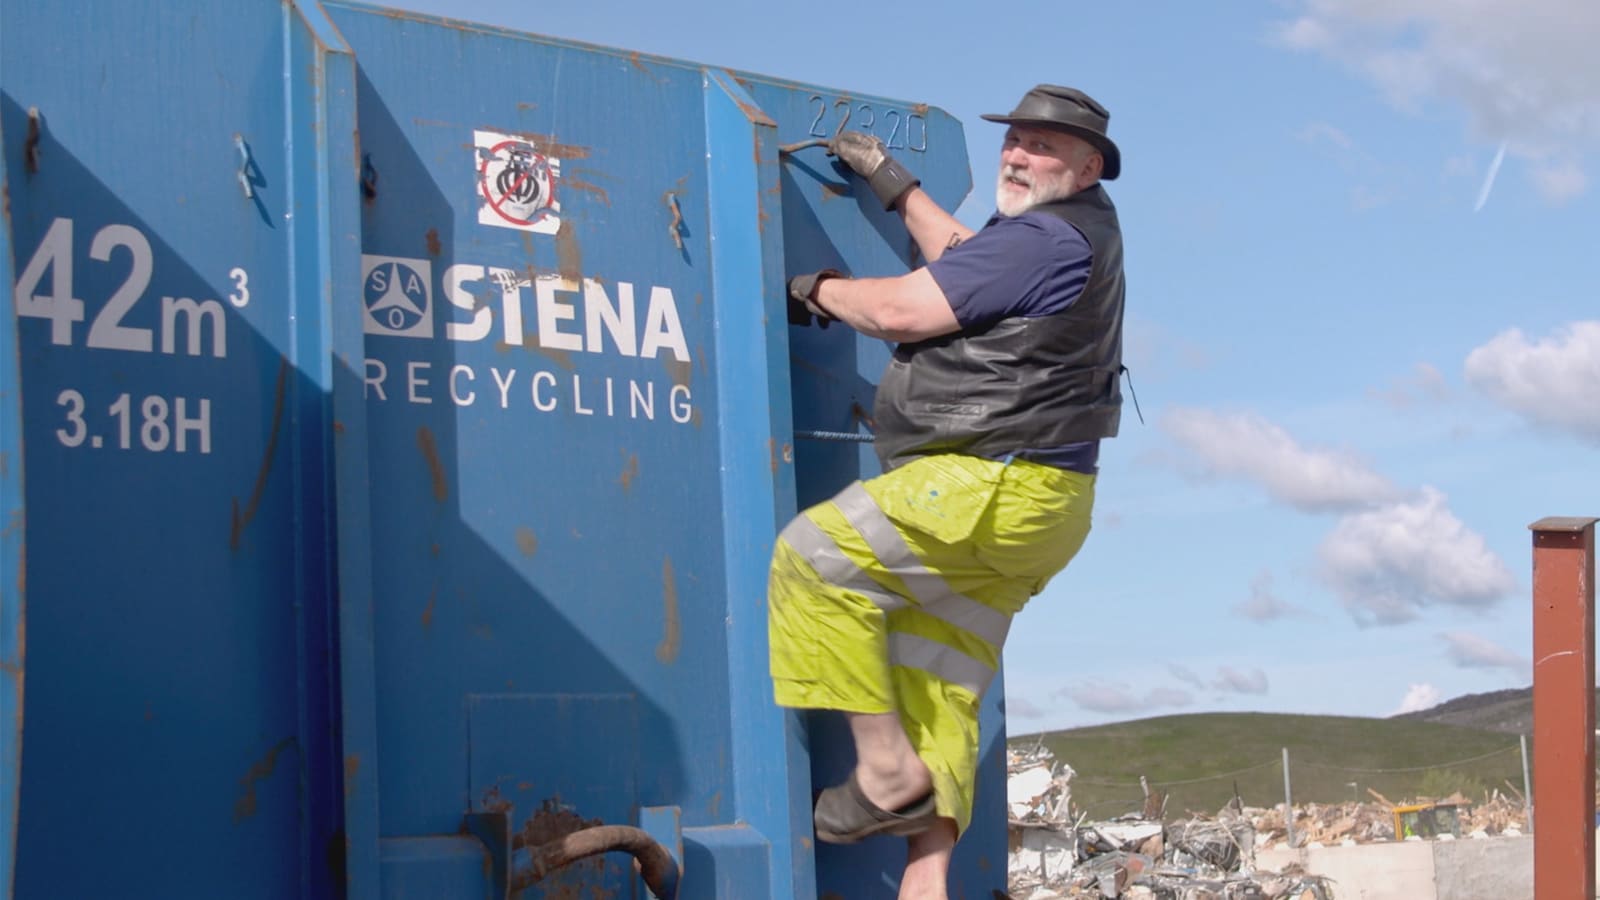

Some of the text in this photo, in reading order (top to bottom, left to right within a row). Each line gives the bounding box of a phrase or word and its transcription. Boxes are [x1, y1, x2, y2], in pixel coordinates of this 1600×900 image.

[442, 264, 691, 363] STENA
[56, 389, 211, 454] 3.18H
[364, 358, 693, 424] RECYCLING
